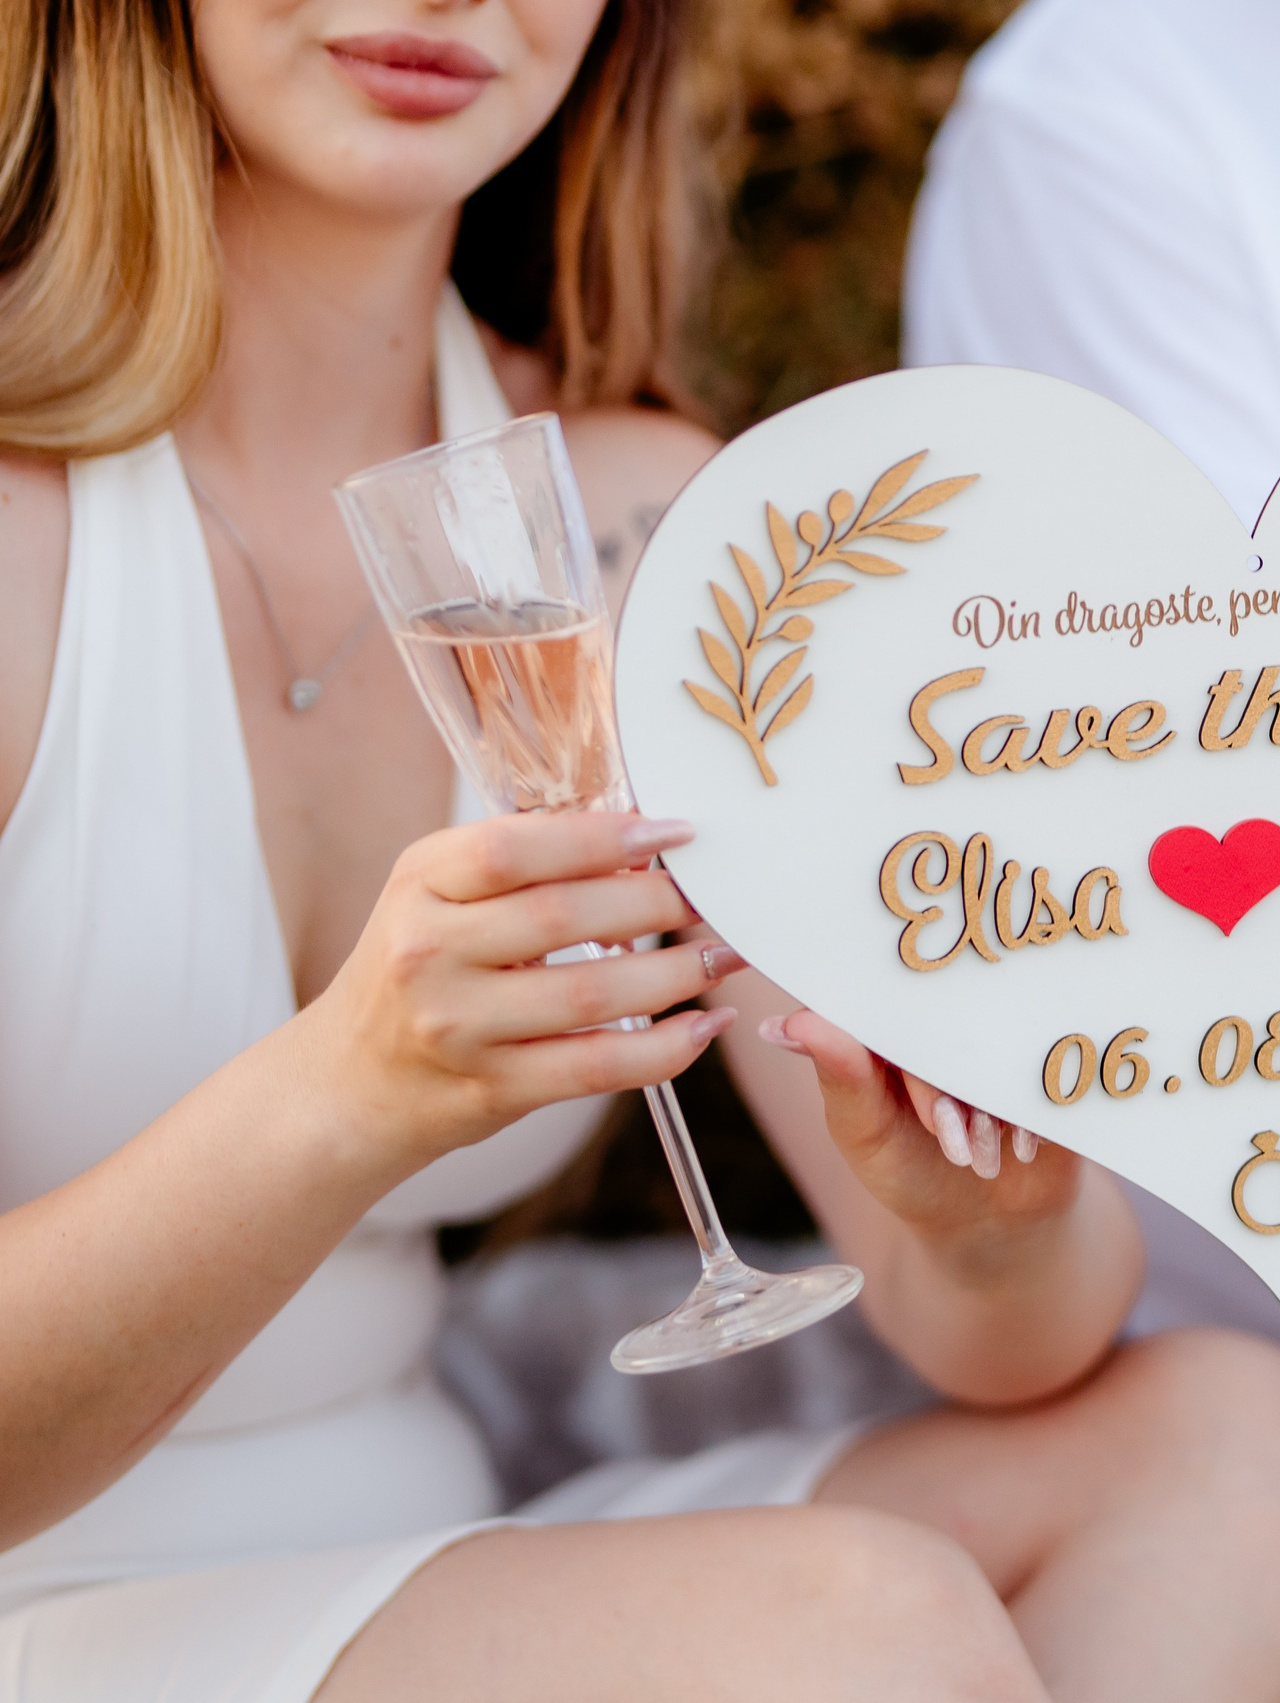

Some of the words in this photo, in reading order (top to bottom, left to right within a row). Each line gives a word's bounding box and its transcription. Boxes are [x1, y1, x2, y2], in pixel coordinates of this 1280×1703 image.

[952, 595, 1040, 649] Din
[1054, 585, 1222, 648] dragoste,
[899, 666, 1177, 786] Save
[879, 831, 1129, 972] Elisa
